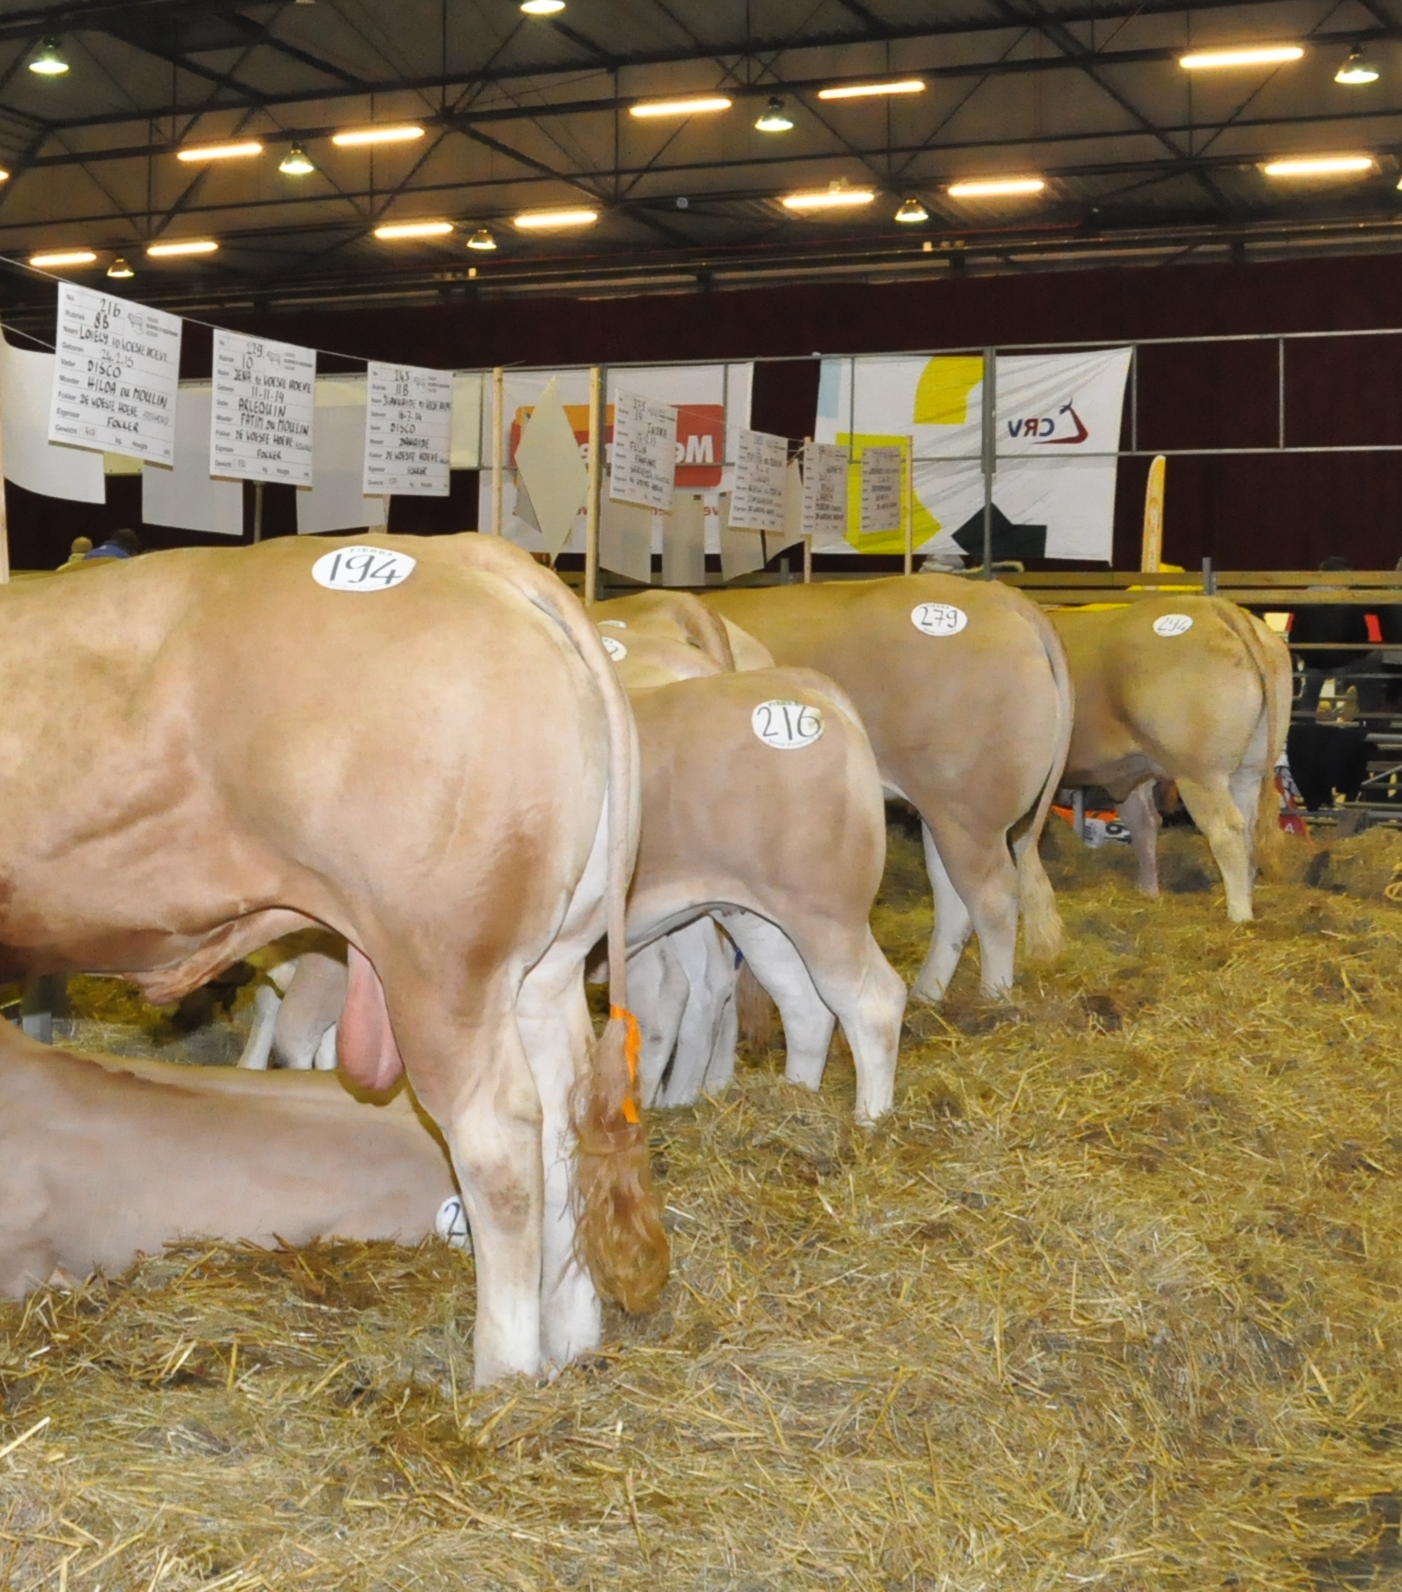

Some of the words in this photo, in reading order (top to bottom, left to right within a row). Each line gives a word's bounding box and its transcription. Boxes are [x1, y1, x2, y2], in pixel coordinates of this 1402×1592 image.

[100, 298, 121, 318] 216
[87, 360, 122, 379] DISCO
[87, 376, 117, 394] HILDA
[132, 387, 168, 410] MOULIN
[106, 416, 139, 433] FOKKER
[329, 553, 403, 585] 194
[918, 606, 958, 629] 279
[757, 706, 821, 741] 216
